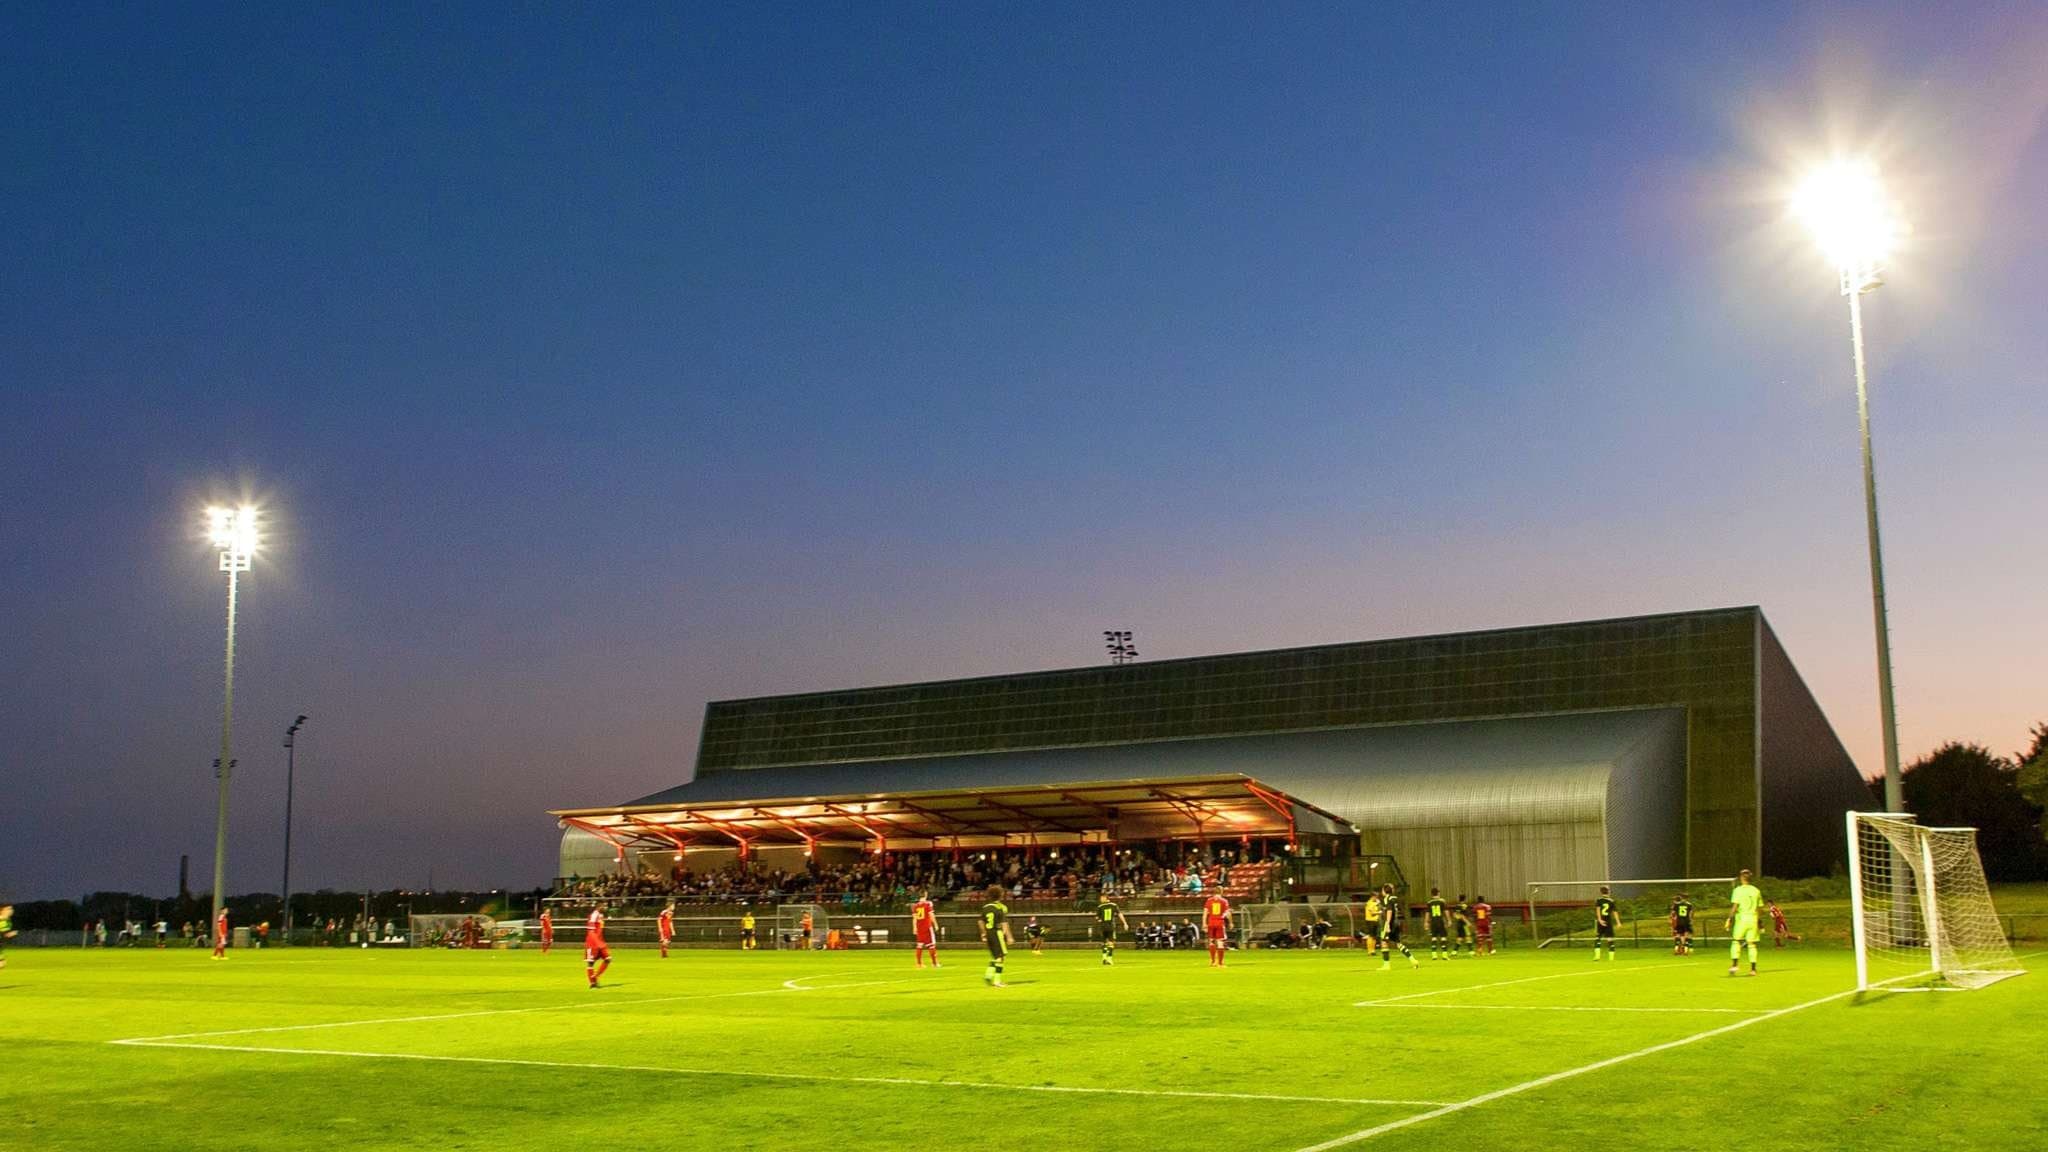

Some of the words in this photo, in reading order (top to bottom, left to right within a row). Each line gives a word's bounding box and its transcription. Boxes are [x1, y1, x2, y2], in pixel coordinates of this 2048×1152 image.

[1104, 908, 1112, 921] 11
[1601, 903, 1609, 916] 2
[985, 912, 995, 929] 3
